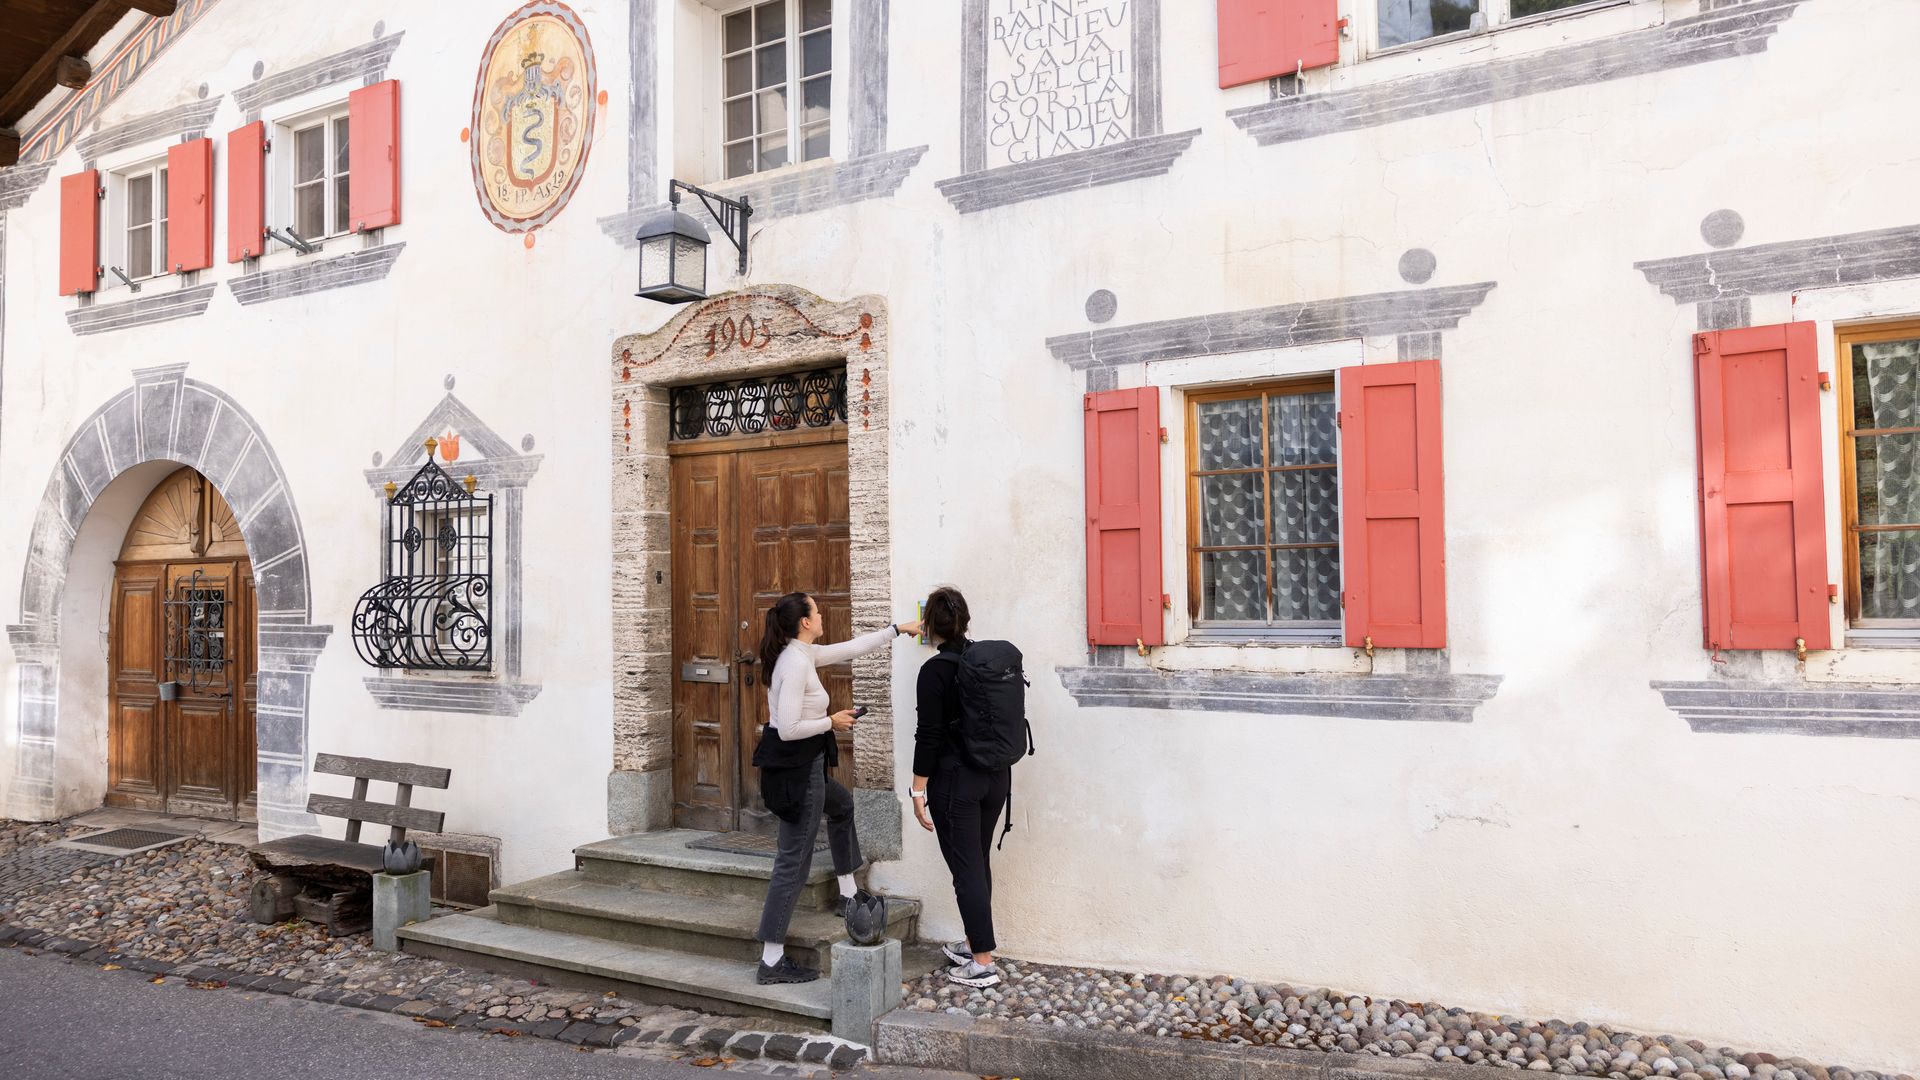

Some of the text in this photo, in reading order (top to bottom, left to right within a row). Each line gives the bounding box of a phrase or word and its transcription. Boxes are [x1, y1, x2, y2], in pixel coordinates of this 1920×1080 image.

[989, 50, 1124, 103] QUEL CHI
[1011, 34, 1114, 79] SAJA
[990, 93, 1131, 147] CUN DIEU
[1008, 120, 1130, 163] GIAJA
[705, 314, 772, 360] 1905
